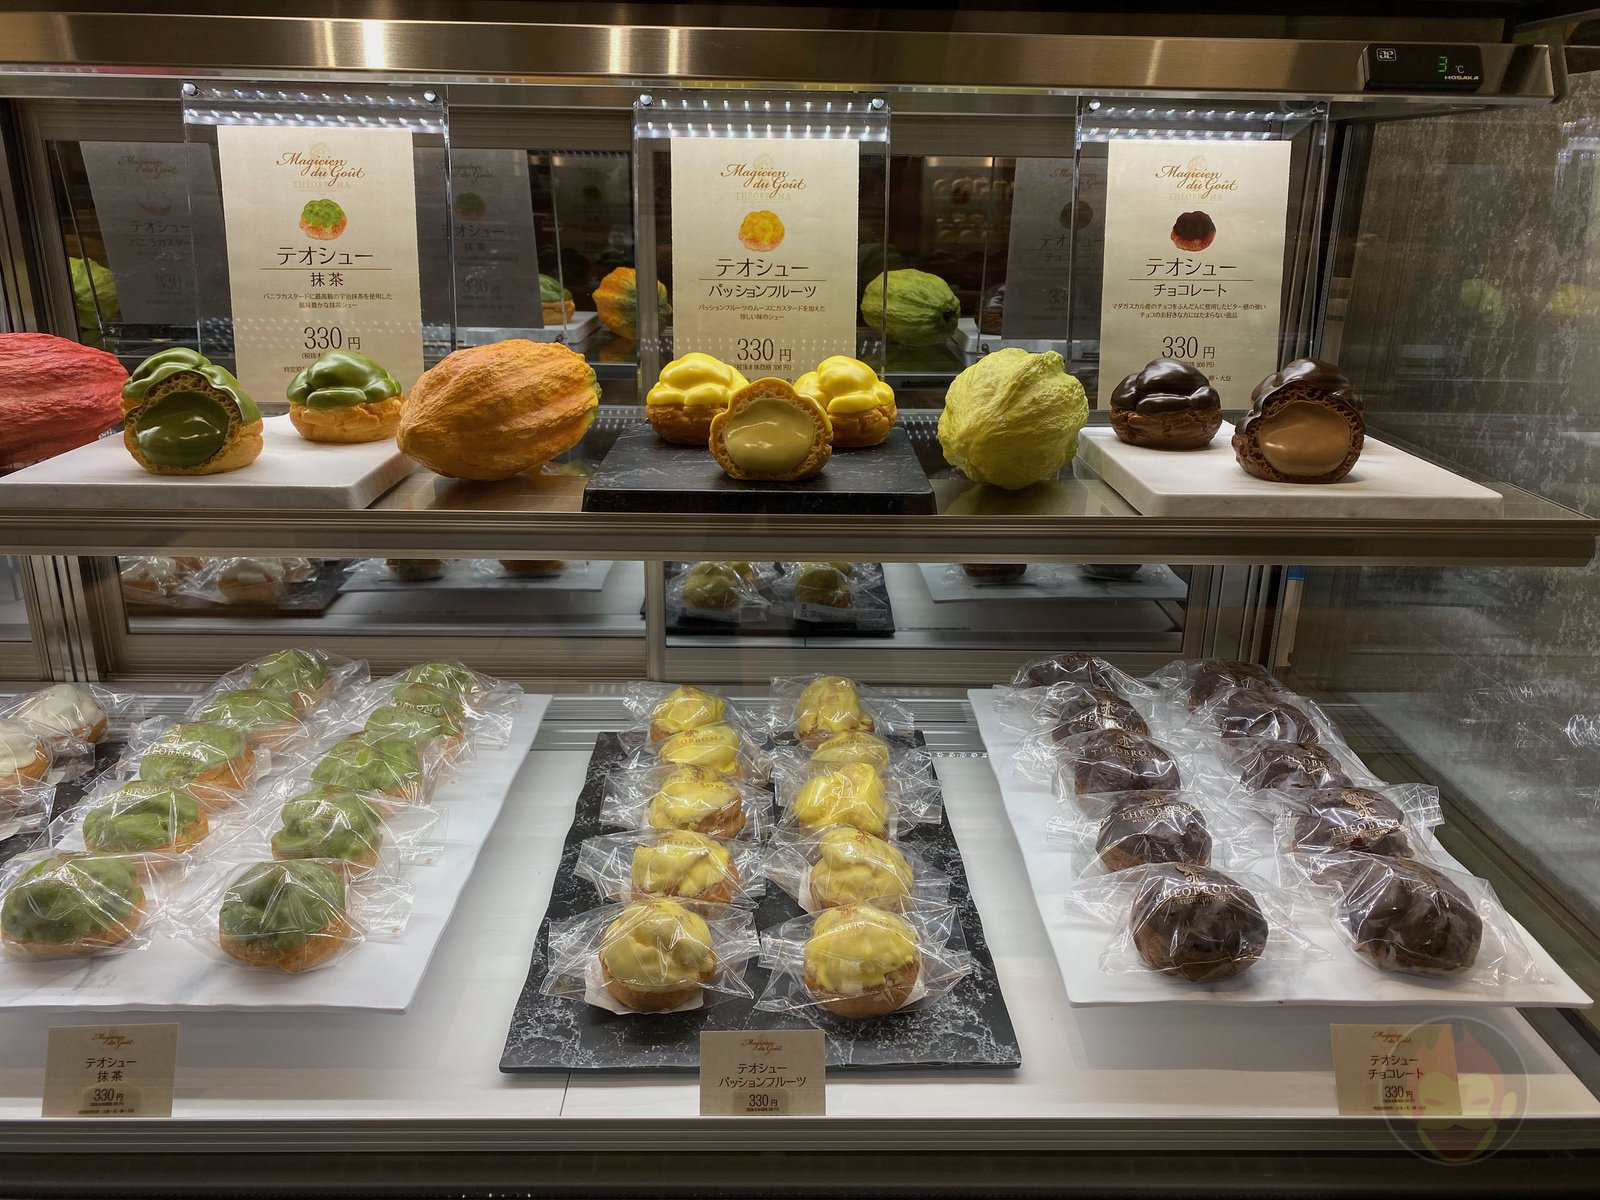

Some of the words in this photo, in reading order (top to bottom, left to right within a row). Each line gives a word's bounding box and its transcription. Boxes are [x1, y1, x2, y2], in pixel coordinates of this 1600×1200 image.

[1438, 56, 1448, 73] 3
[276, 152, 347, 176] Magicien
[311, 167, 328, 177] du
[328, 165, 366, 186] Goût
[720, 164, 789, 187] Magicien
[1155, 164, 1222, 189] Magicien
[752, 179, 770, 189] du
[769, 176, 807, 198] Goût
[1186, 179, 1203, 190] du
[276, 246, 373, 266] テオシュー
[715, 257, 809, 277] テオシュー
[1145, 257, 1238, 277] テオシュー
[311, 272, 344, 287] 抹茶
[708, 283, 817, 298] パッションフルーツ
[1153, 283, 1227, 297] チョコレート
[304, 326, 342, 350] 330
[348, 337, 360, 350] 円
[736, 338, 774, 361] 330
[780, 348, 792, 361] 円
[1161, 336, 1199, 359] 330
[1203, 346, 1215, 359] 円
[85, 1057, 137, 1069] テオシュー
[1370, 1055, 1420, 1066] テオシュー
[738, 1063, 788, 1074] テオシュー
[1368, 1067, 1425, 1080] チョコレート
[97, 1071, 123, 1082] 抹茶
[719, 1076, 807, 1088] パッションフルーツ
[94, 1088, 115, 1101] 330
[1384, 1086, 1404, 1098] 330
[749, 1094, 769, 1107] 330
[771, 1099, 778, 1107] 円
